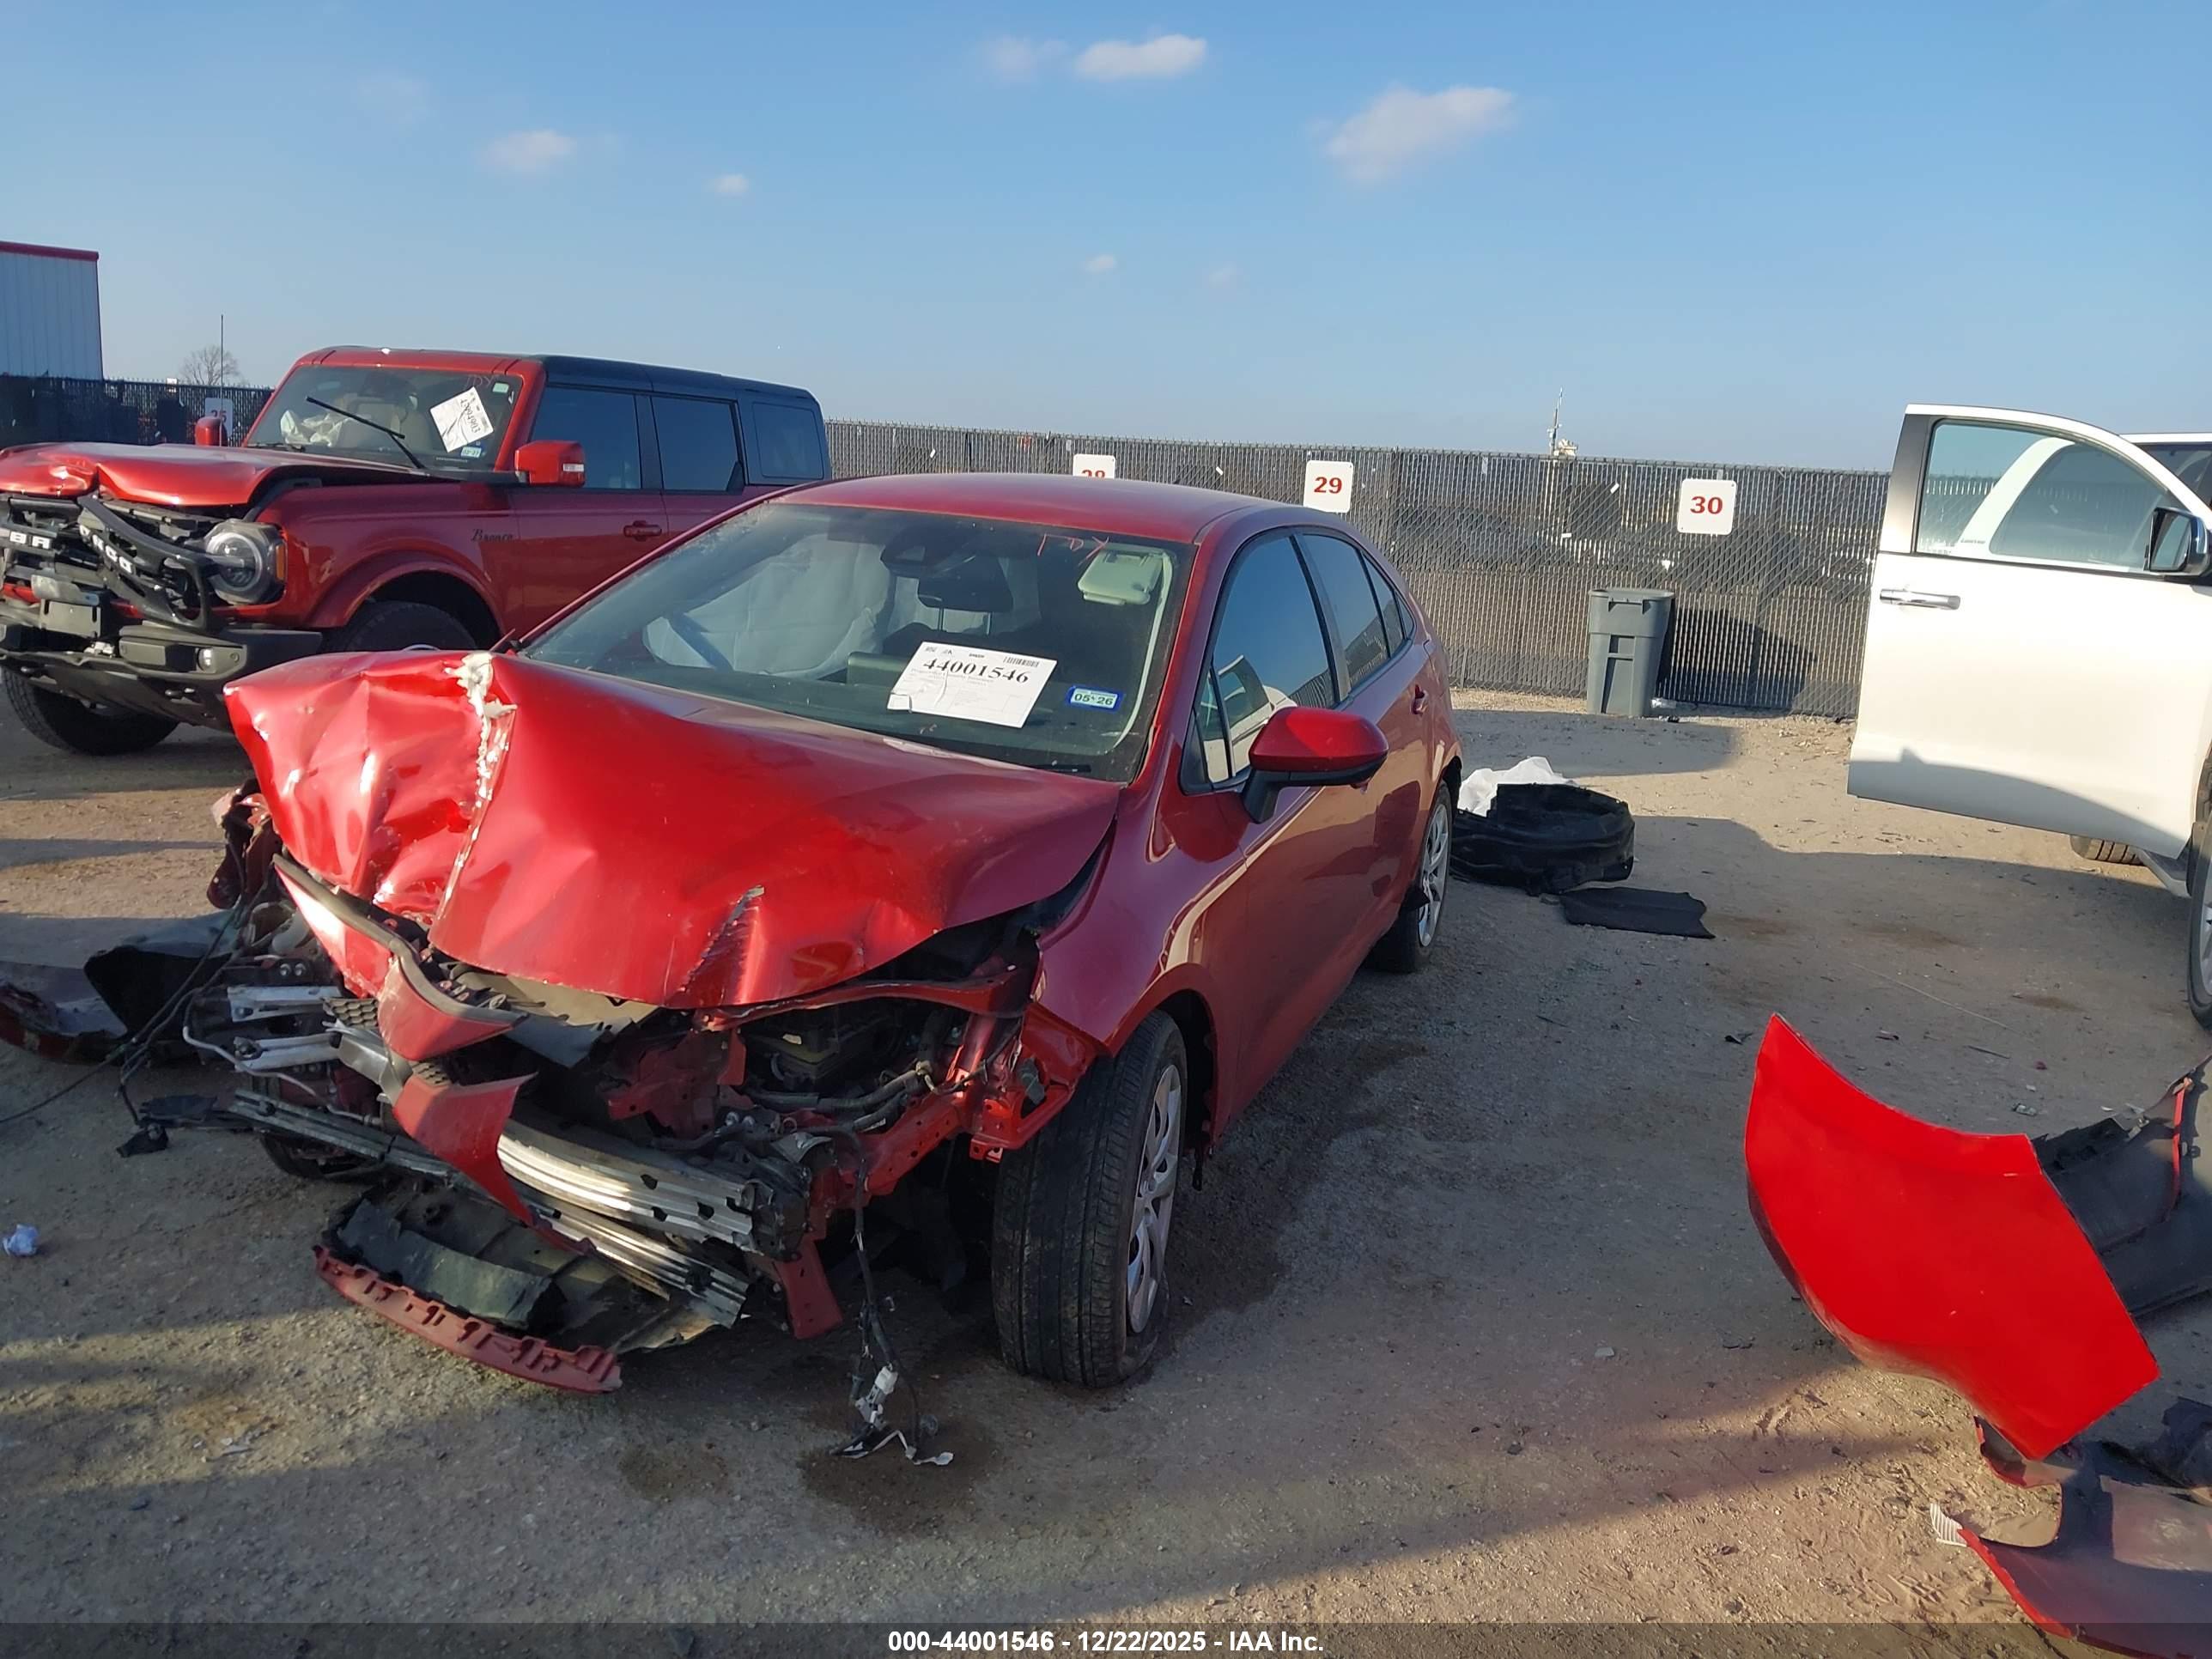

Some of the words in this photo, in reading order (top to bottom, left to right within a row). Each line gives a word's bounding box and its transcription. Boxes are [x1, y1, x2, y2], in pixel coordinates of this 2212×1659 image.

[1314, 477, 1342, 494] 29
[1690, 496, 1723, 514] 30
[923, 658, 1029, 684] 44001546
